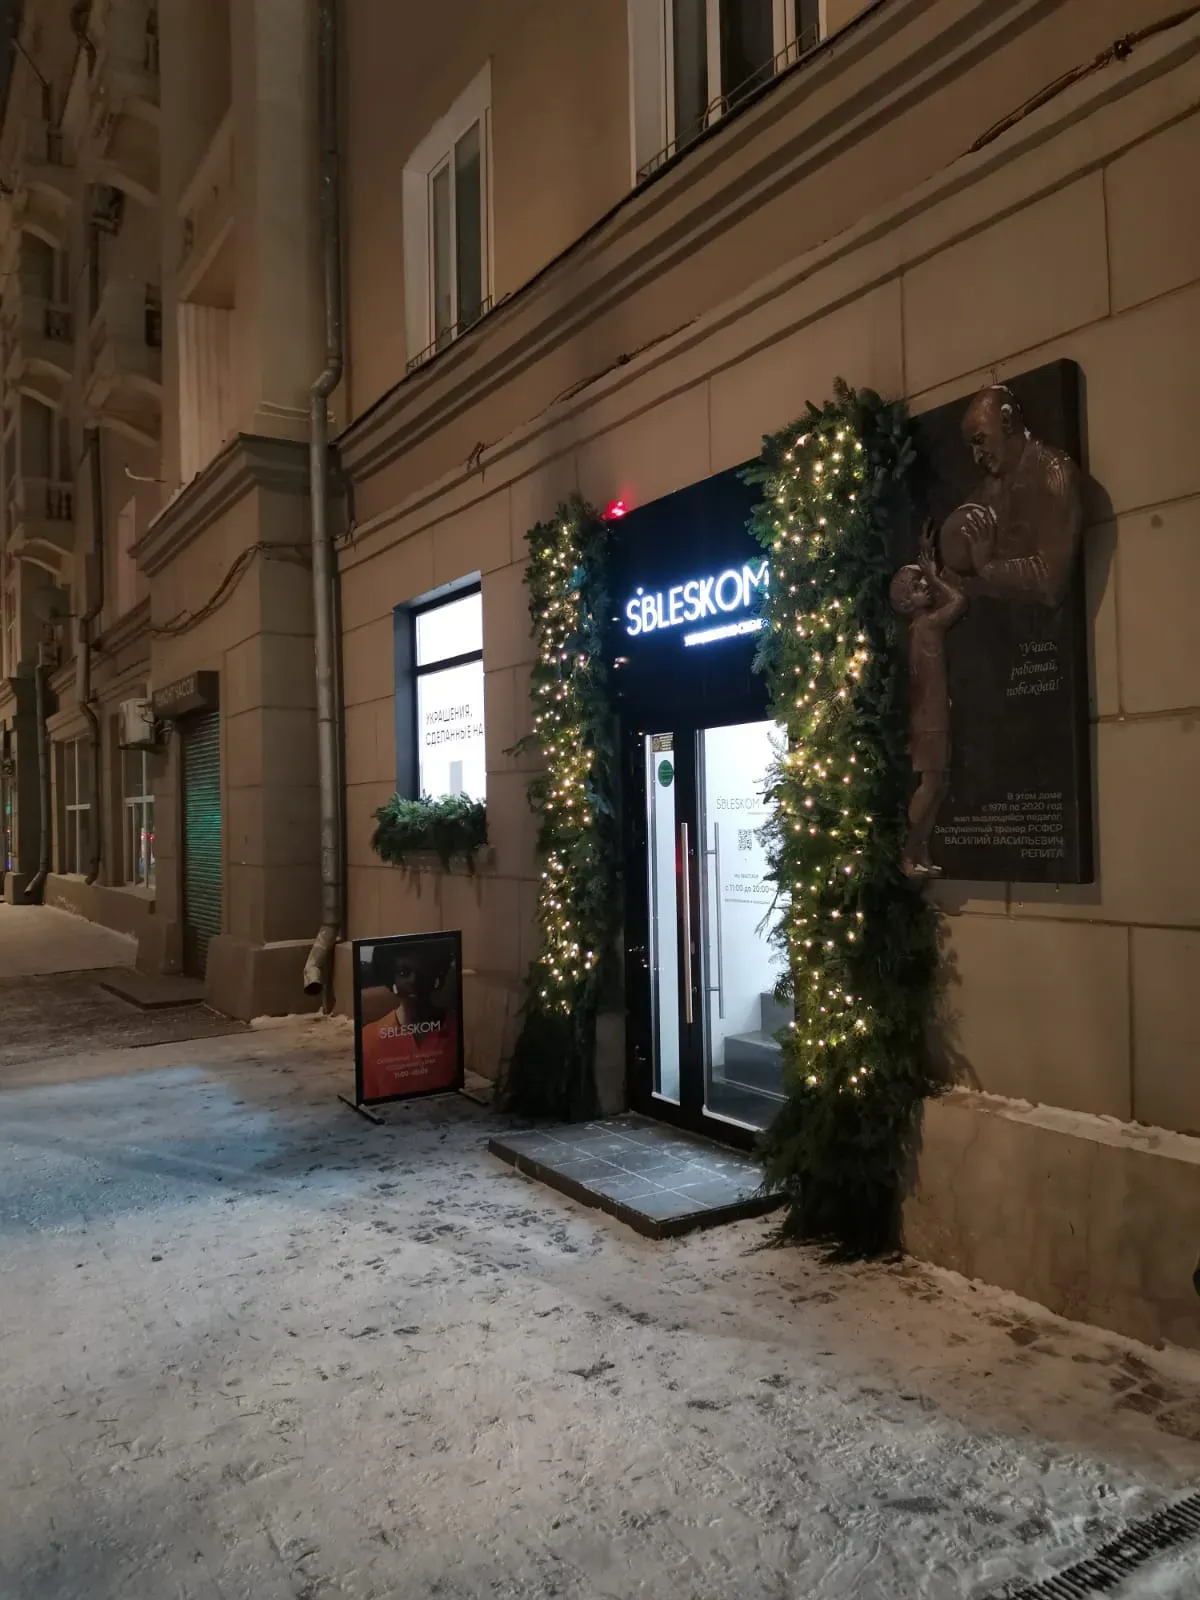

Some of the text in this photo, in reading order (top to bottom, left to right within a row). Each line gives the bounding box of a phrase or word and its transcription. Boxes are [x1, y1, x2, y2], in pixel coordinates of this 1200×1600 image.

[426, 725, 471, 747] СДЕЛАННЫЕ
[716, 797, 760, 810] SBLESKOM
[1028, 824, 1063, 832] РСФСР
[944, 834, 1064, 845] ВАСИЛИЙ ВАСИЛЬЕВИЧ
[379, 1020, 441, 1039] SBLESKOM
